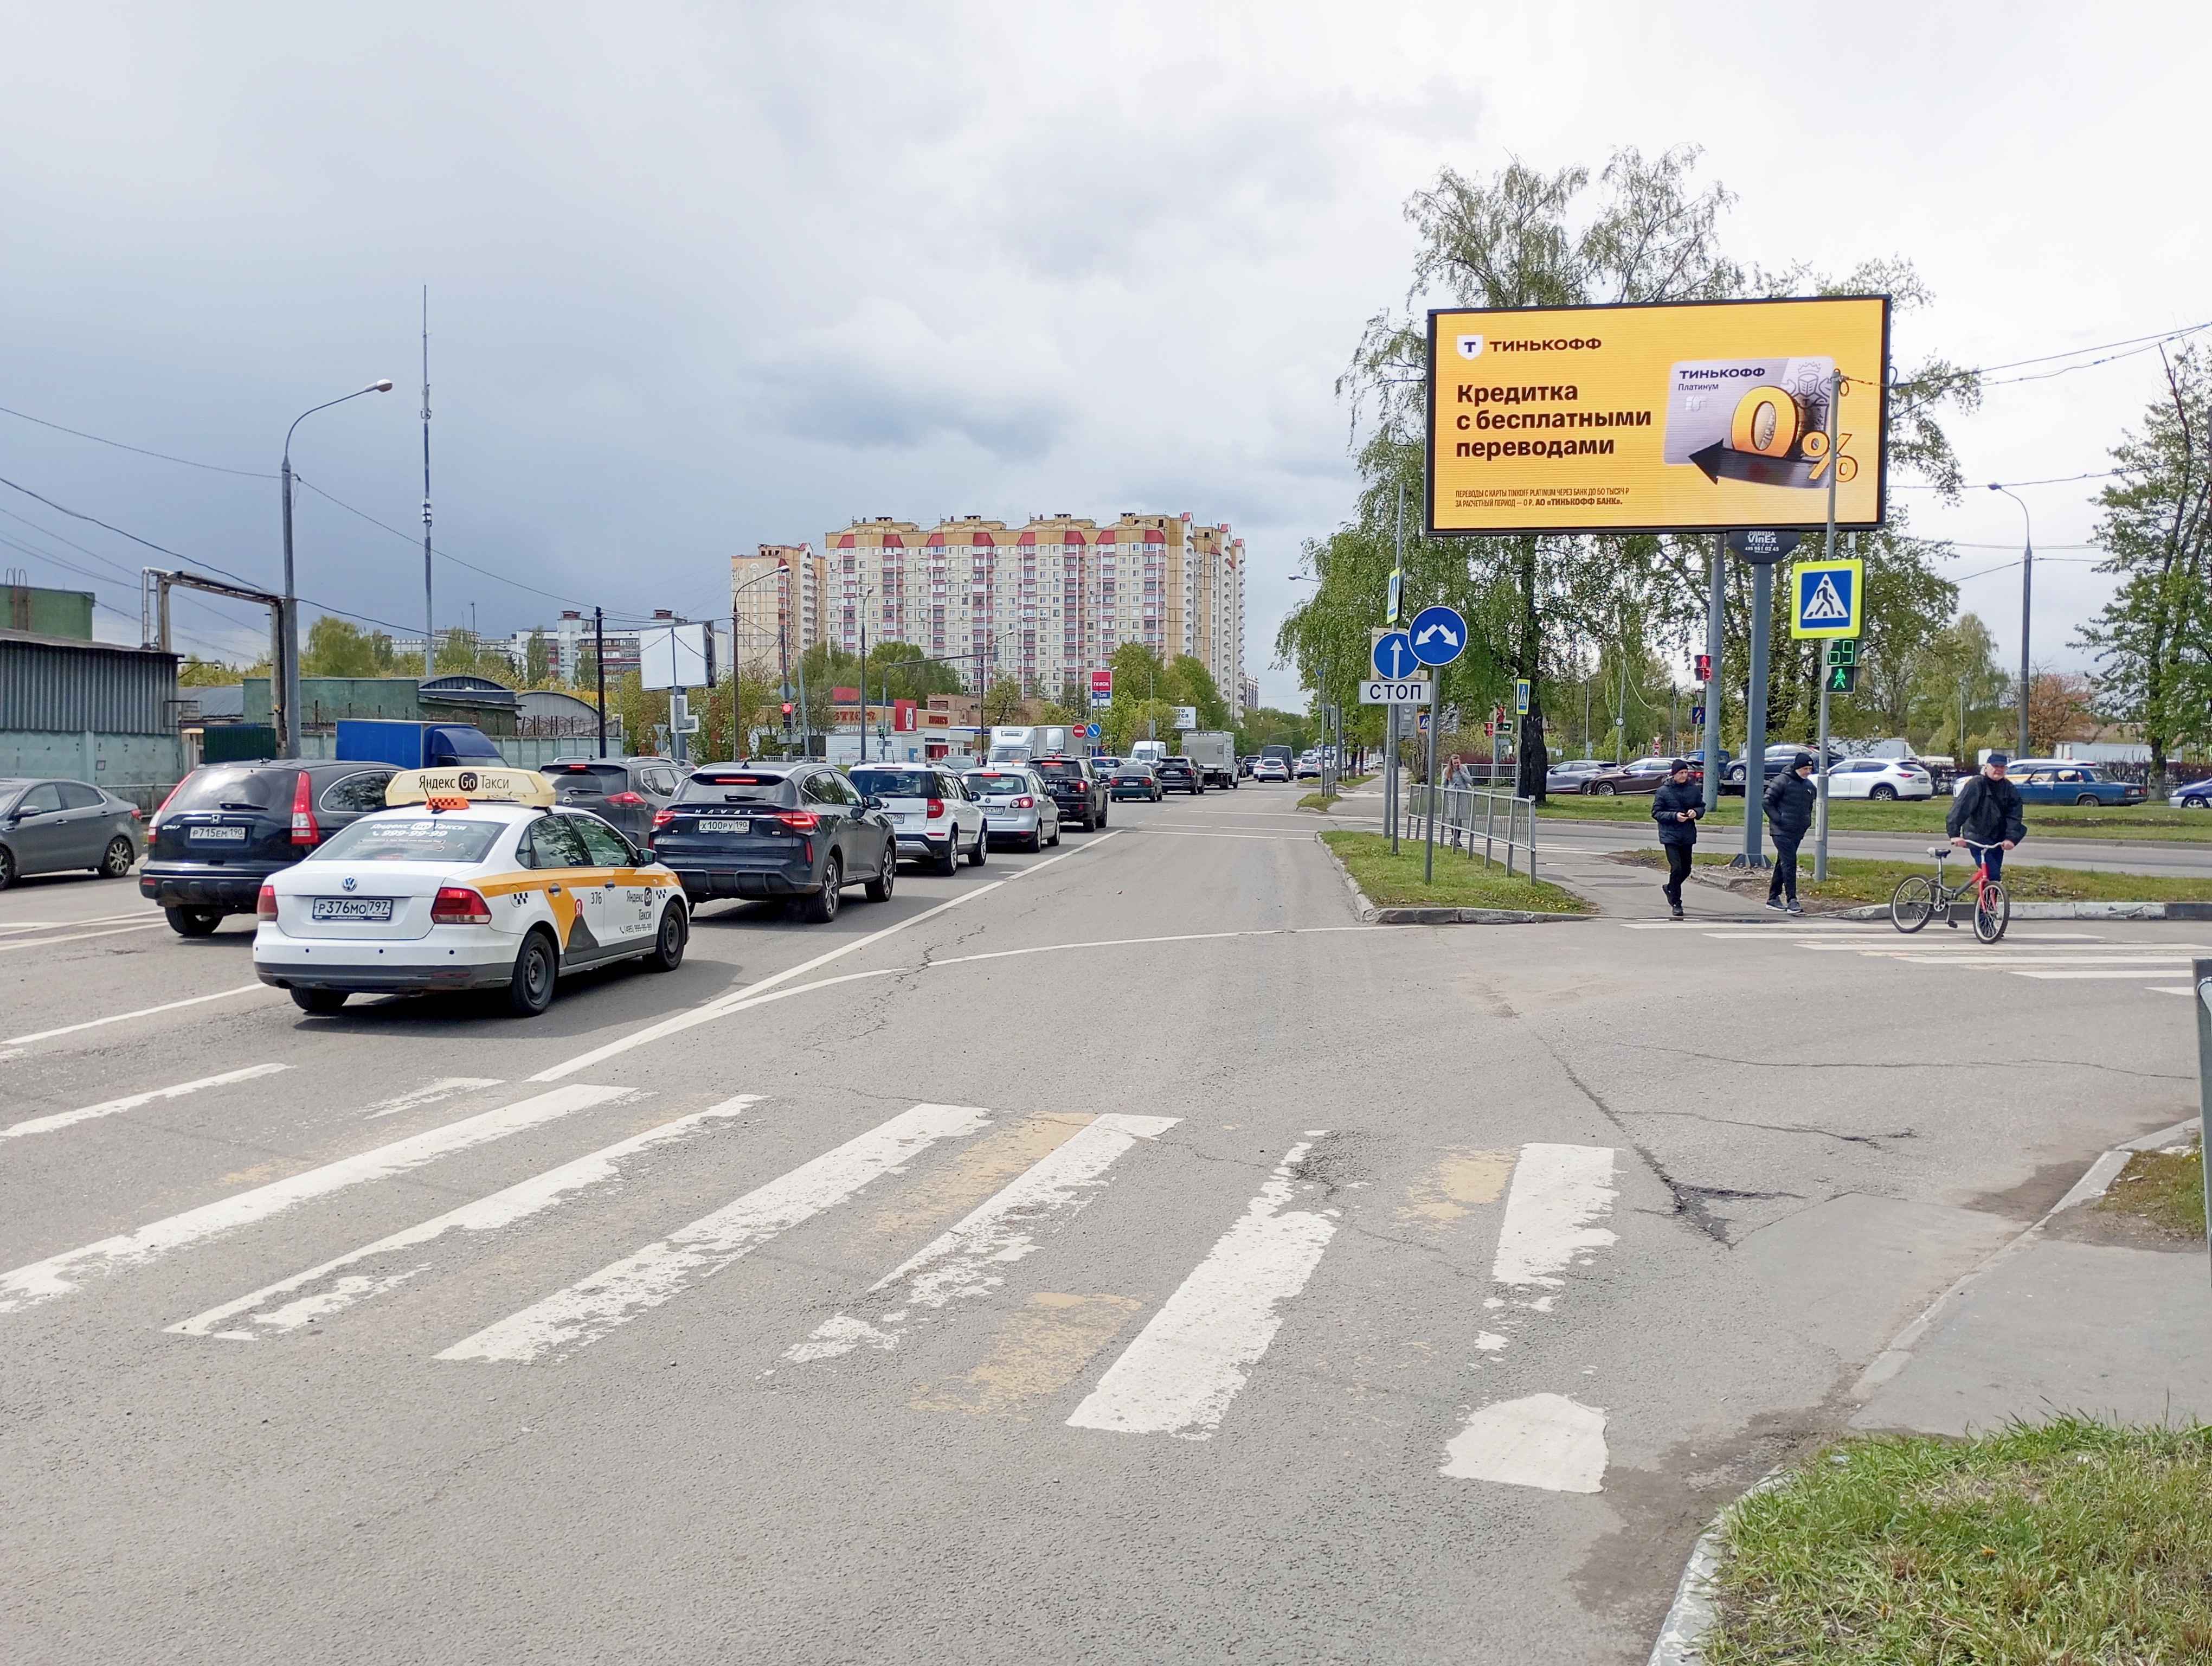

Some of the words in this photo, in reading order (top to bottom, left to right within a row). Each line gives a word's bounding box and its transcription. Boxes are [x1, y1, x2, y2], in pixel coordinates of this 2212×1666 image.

[1489, 338, 1602, 352] ТИНЬКОФФ
[1679, 368, 1766, 379] ТИНЬКОФФ
[1457, 385, 1578, 407] Кредитка
[1456, 414, 1470, 430] с
[1476, 409, 1651, 430] бесплатными
[1456, 439, 1614, 461] переводами
[1456, 490, 1483, 498] ПЕРЕВОДЫ
[1588, 488, 1596, 496] ДО
[1495, 499, 1515, 508] ПЕРИОД
[1369, 684, 1422, 700] СТОП
[419, 775, 456, 790] Яндекс
[460, 774, 476, 789] Go
[480, 774, 510, 789] Такси
[591, 892, 602, 905] 376
[627, 890, 644, 905] Яндекс
[319, 901, 367, 914] Р376МО
[369, 901, 388, 912] 797
[639, 909, 652, 920] Такси
